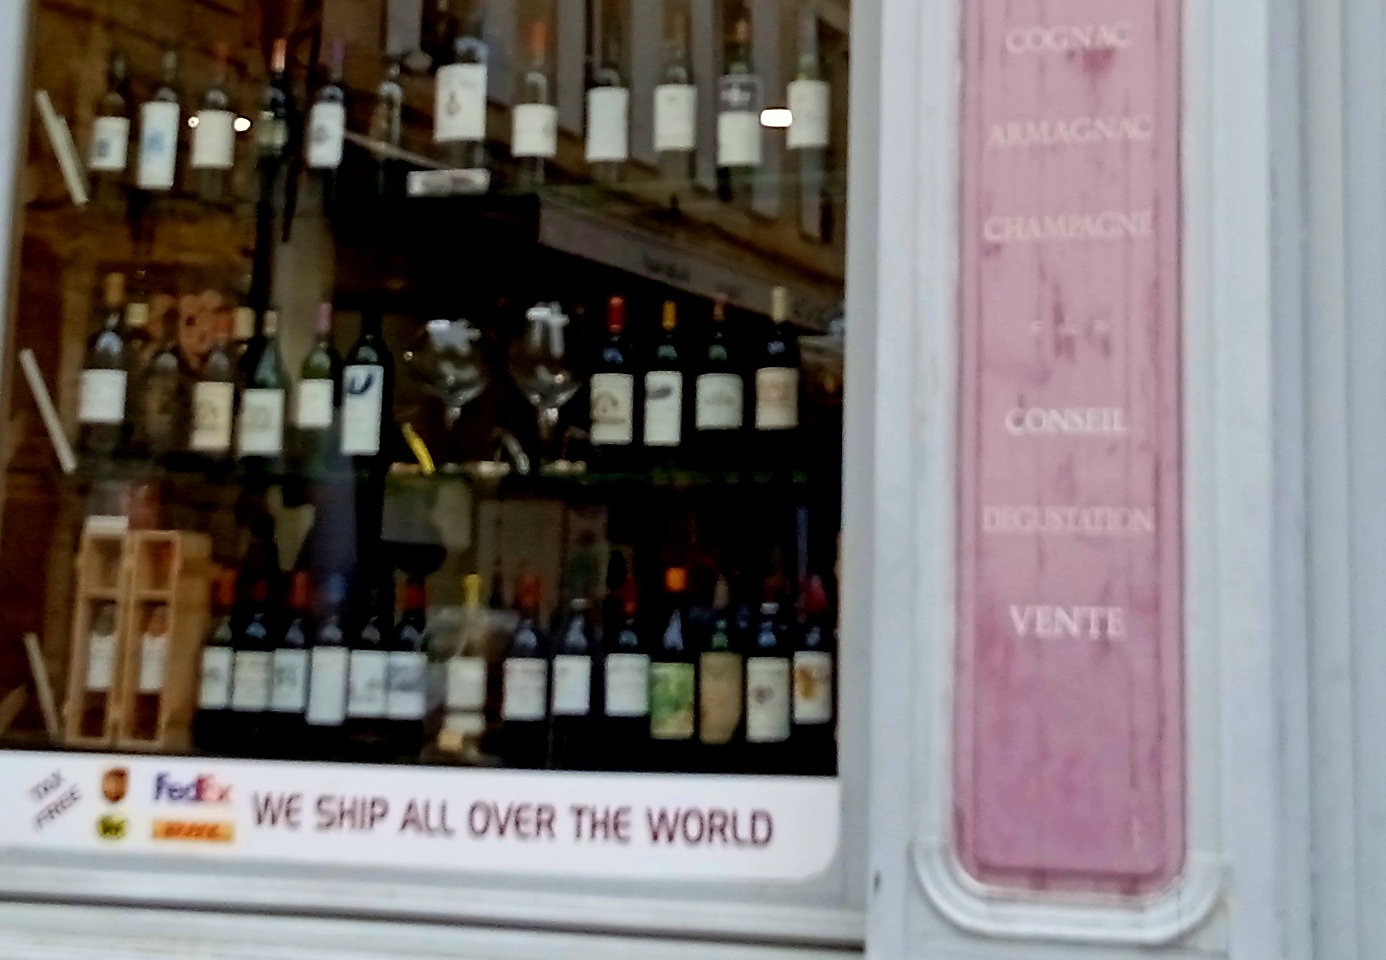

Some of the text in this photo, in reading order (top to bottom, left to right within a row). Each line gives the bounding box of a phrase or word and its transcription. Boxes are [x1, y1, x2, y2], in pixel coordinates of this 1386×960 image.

[1005, 21, 1132, 53] COGNAC
[987, 113, 1153, 146] ARMAGNAC
[983, 210, 1154, 241] CHAMPAGNE
[1005, 407, 1127, 435] CONSEIL
[982, 504, 1155, 533] DEGUSTATION
[1009, 604, 1125, 638] VENTE
[154, 772, 232, 802] FedEx
[253, 792, 775, 848] WE SHIP ALL OVER THE WORLD
